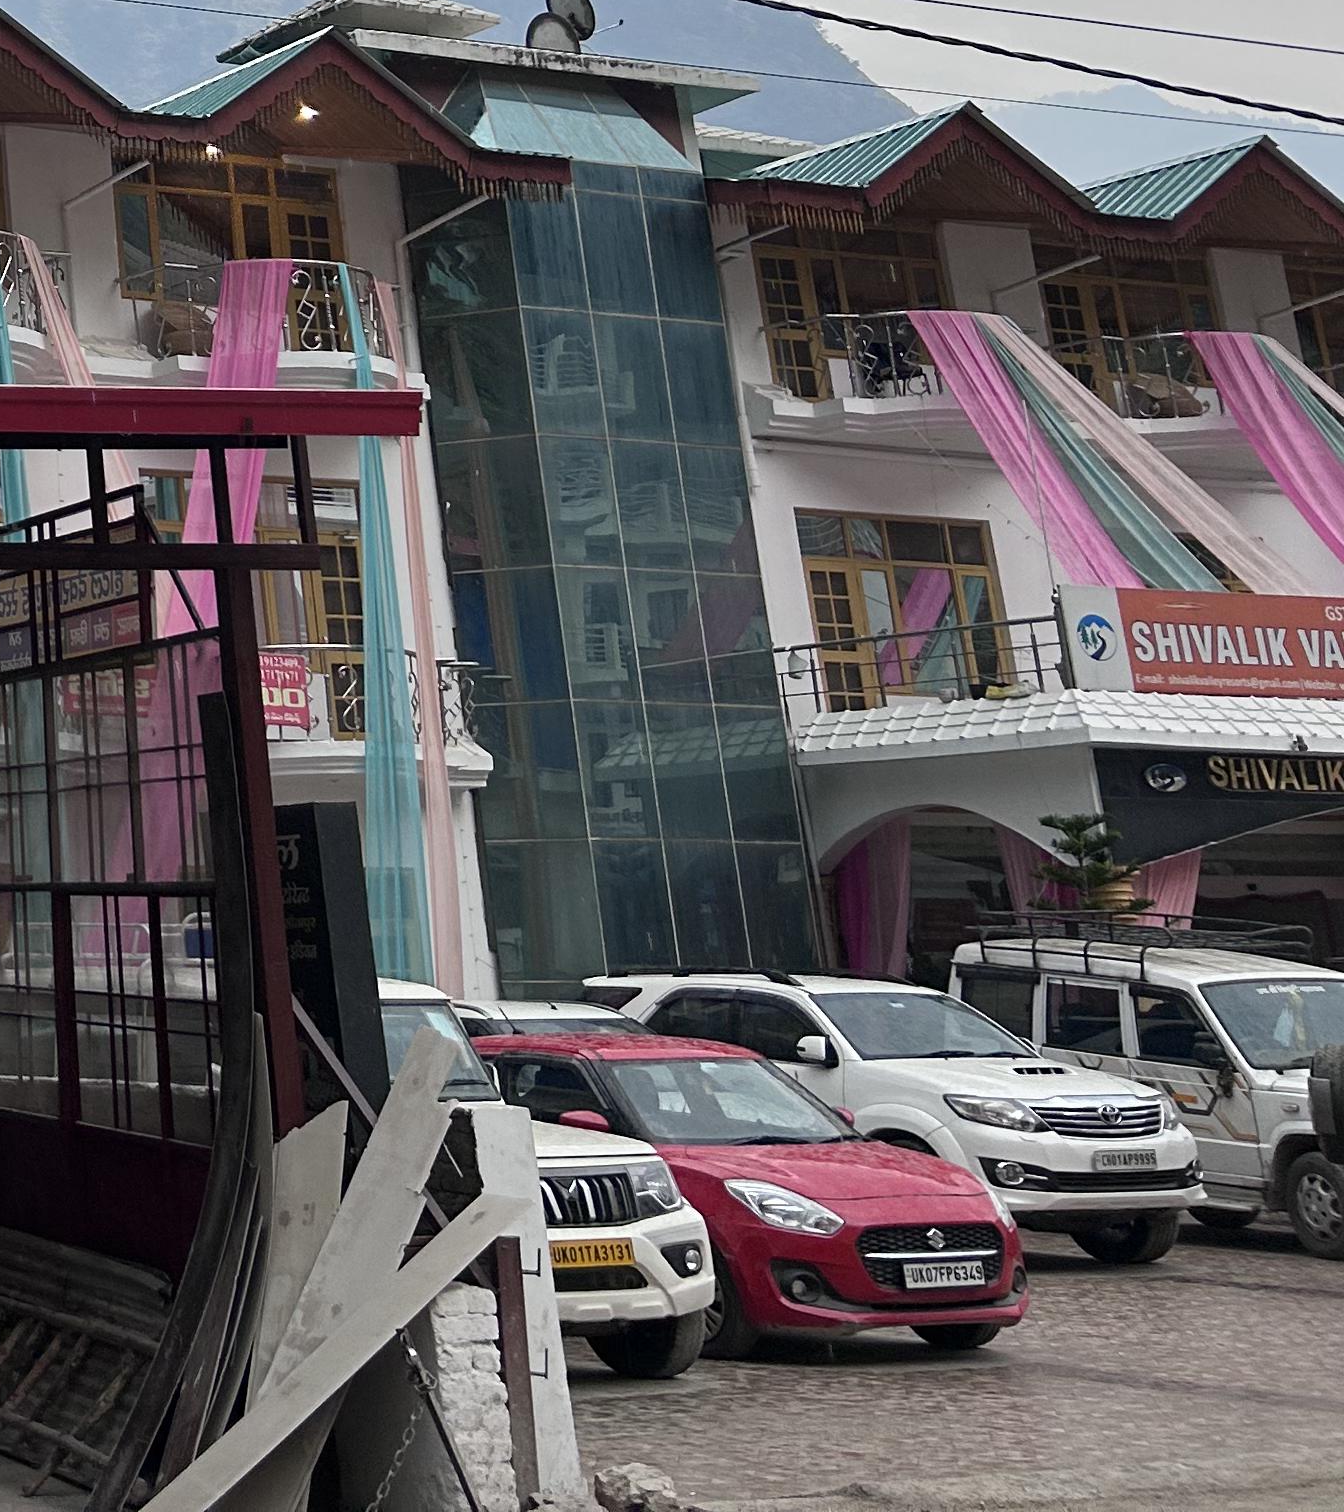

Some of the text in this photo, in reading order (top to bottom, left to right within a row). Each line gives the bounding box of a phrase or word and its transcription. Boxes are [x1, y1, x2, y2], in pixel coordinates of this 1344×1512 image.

[1131, 620, 1344, 669] SHIVALIK VA
[1208, 755, 1344, 792] SHIVALIK
[553, 1243, 632, 1263] UK01TA3131
[912, 1265, 983, 1283] UK07FP6349
